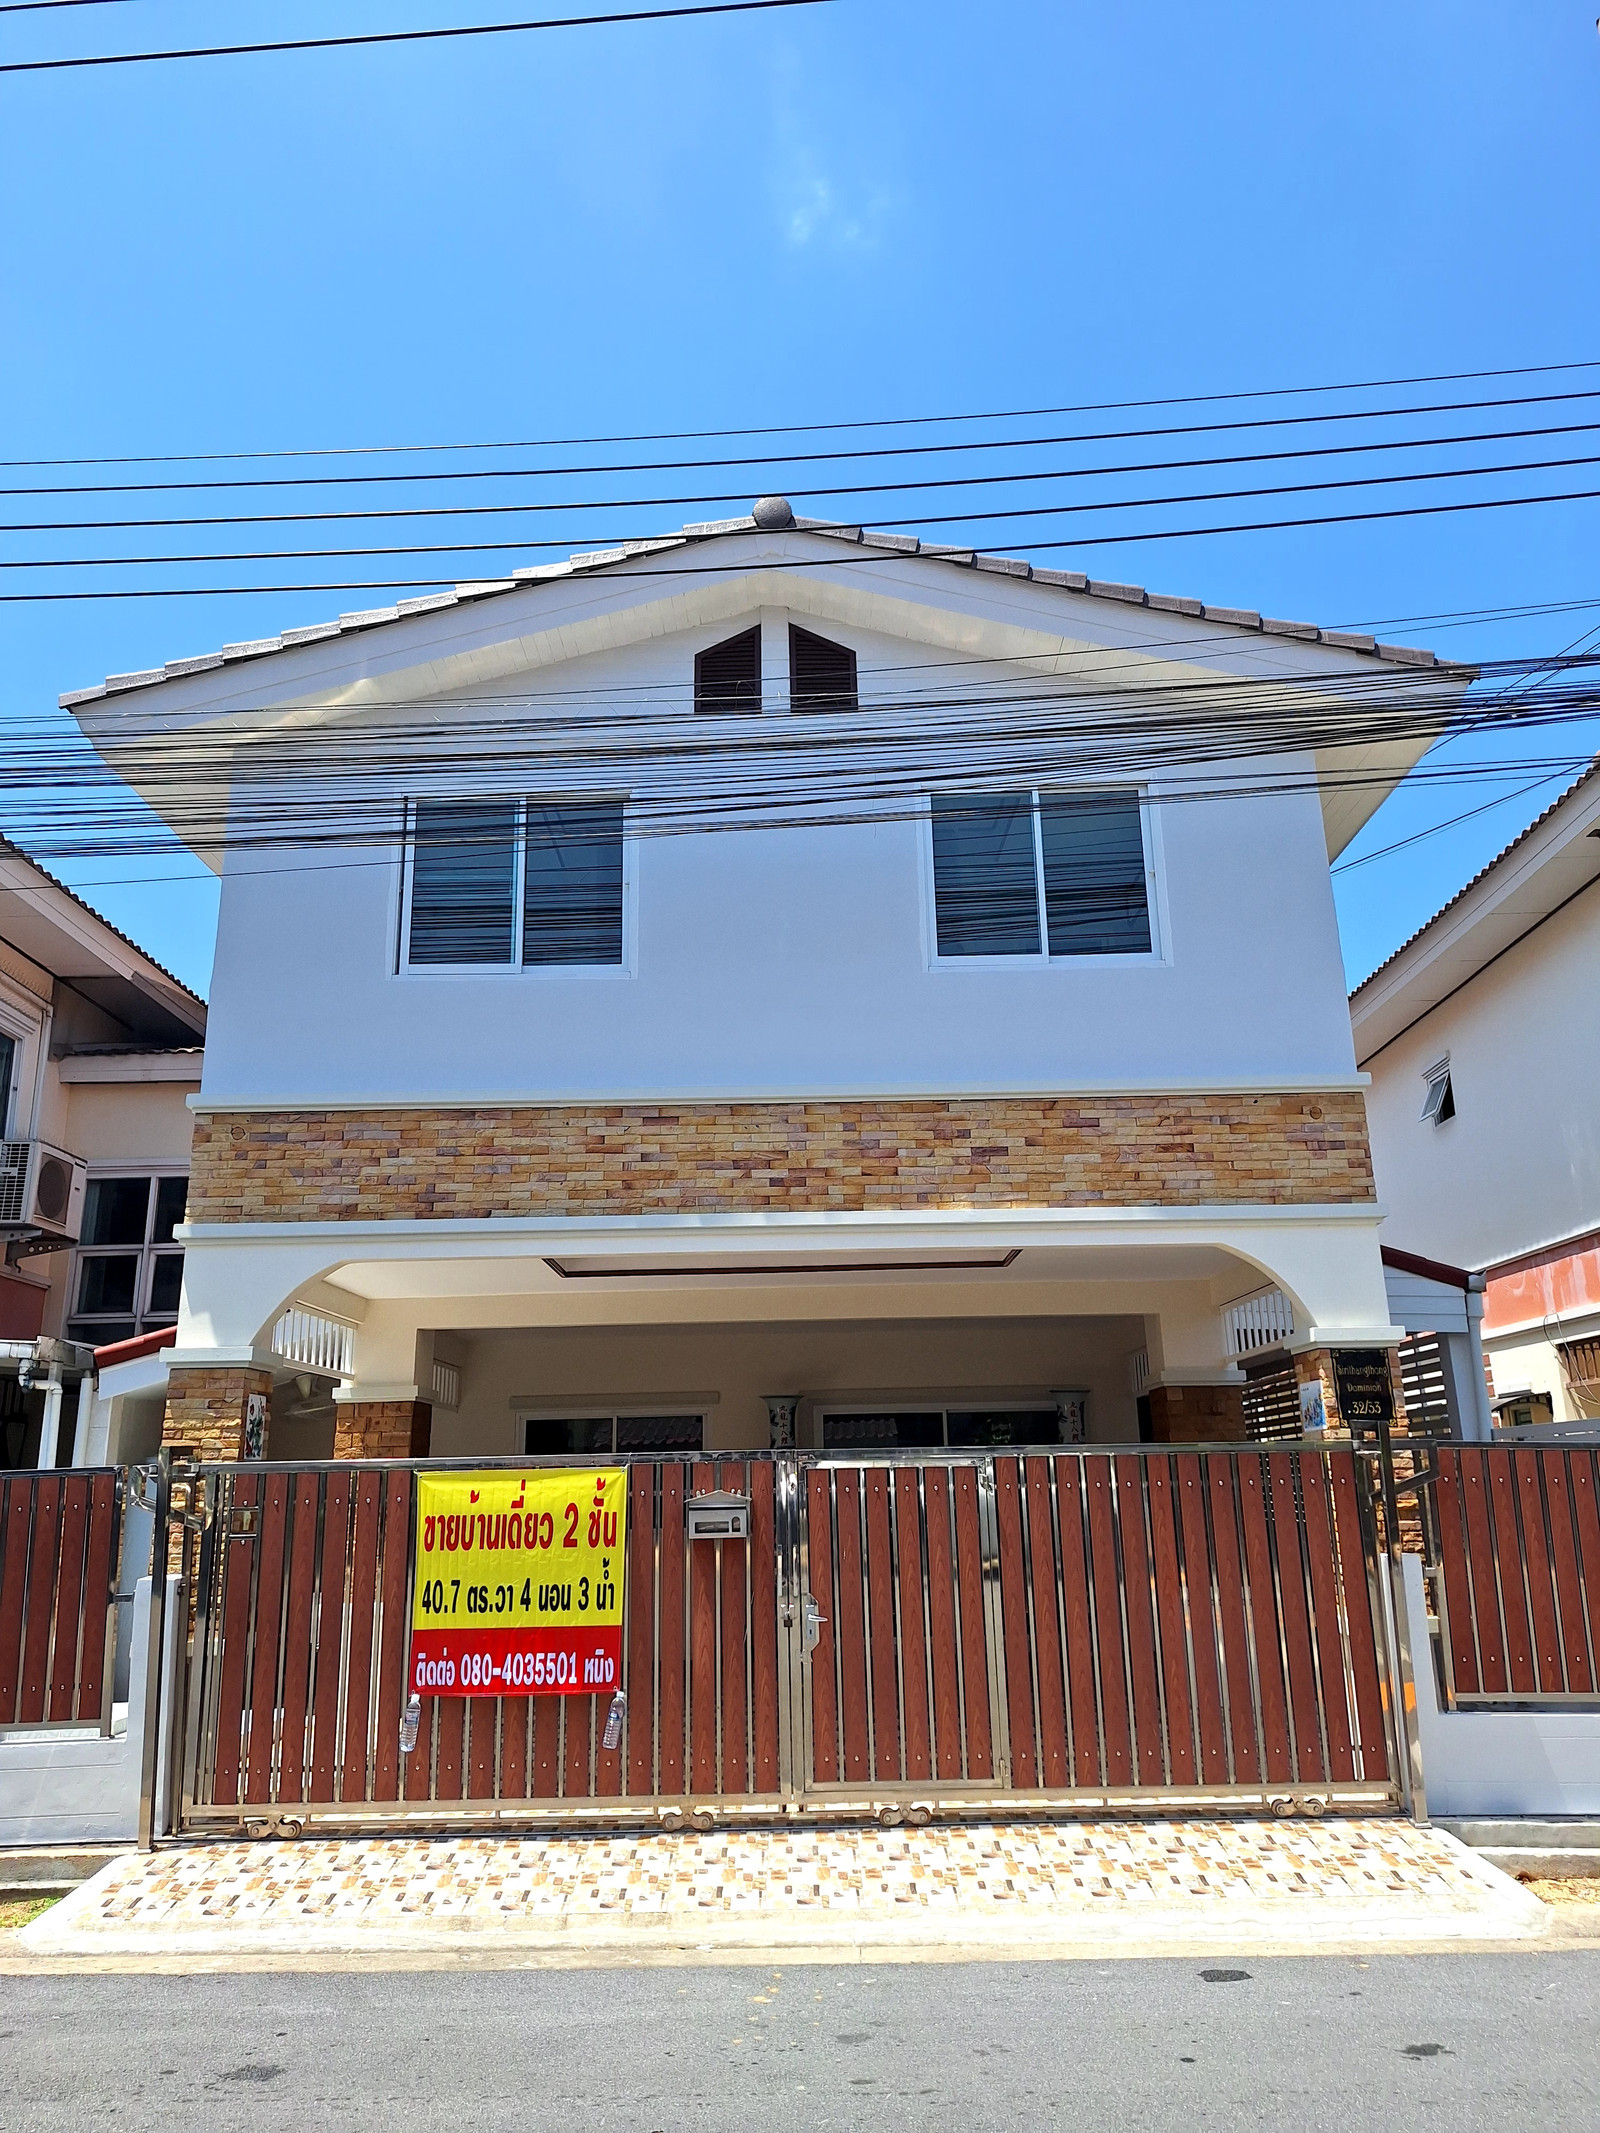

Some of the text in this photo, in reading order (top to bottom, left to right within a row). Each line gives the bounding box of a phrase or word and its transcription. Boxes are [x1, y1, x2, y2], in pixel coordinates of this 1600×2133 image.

[1346, 1382, 1382, 1393] Dominion
[1352, 1399, 1382, 1415] 32/53
[423, 1477, 618, 1552] ขายบ้านเดี่ยว 2 ชั้น
[421, 1557, 615, 1614] 40.7 ตร.วา 4 นอน 3 น้ำ
[415, 1647, 615, 1687] ติดต่อ 080-4035501 หนิง
